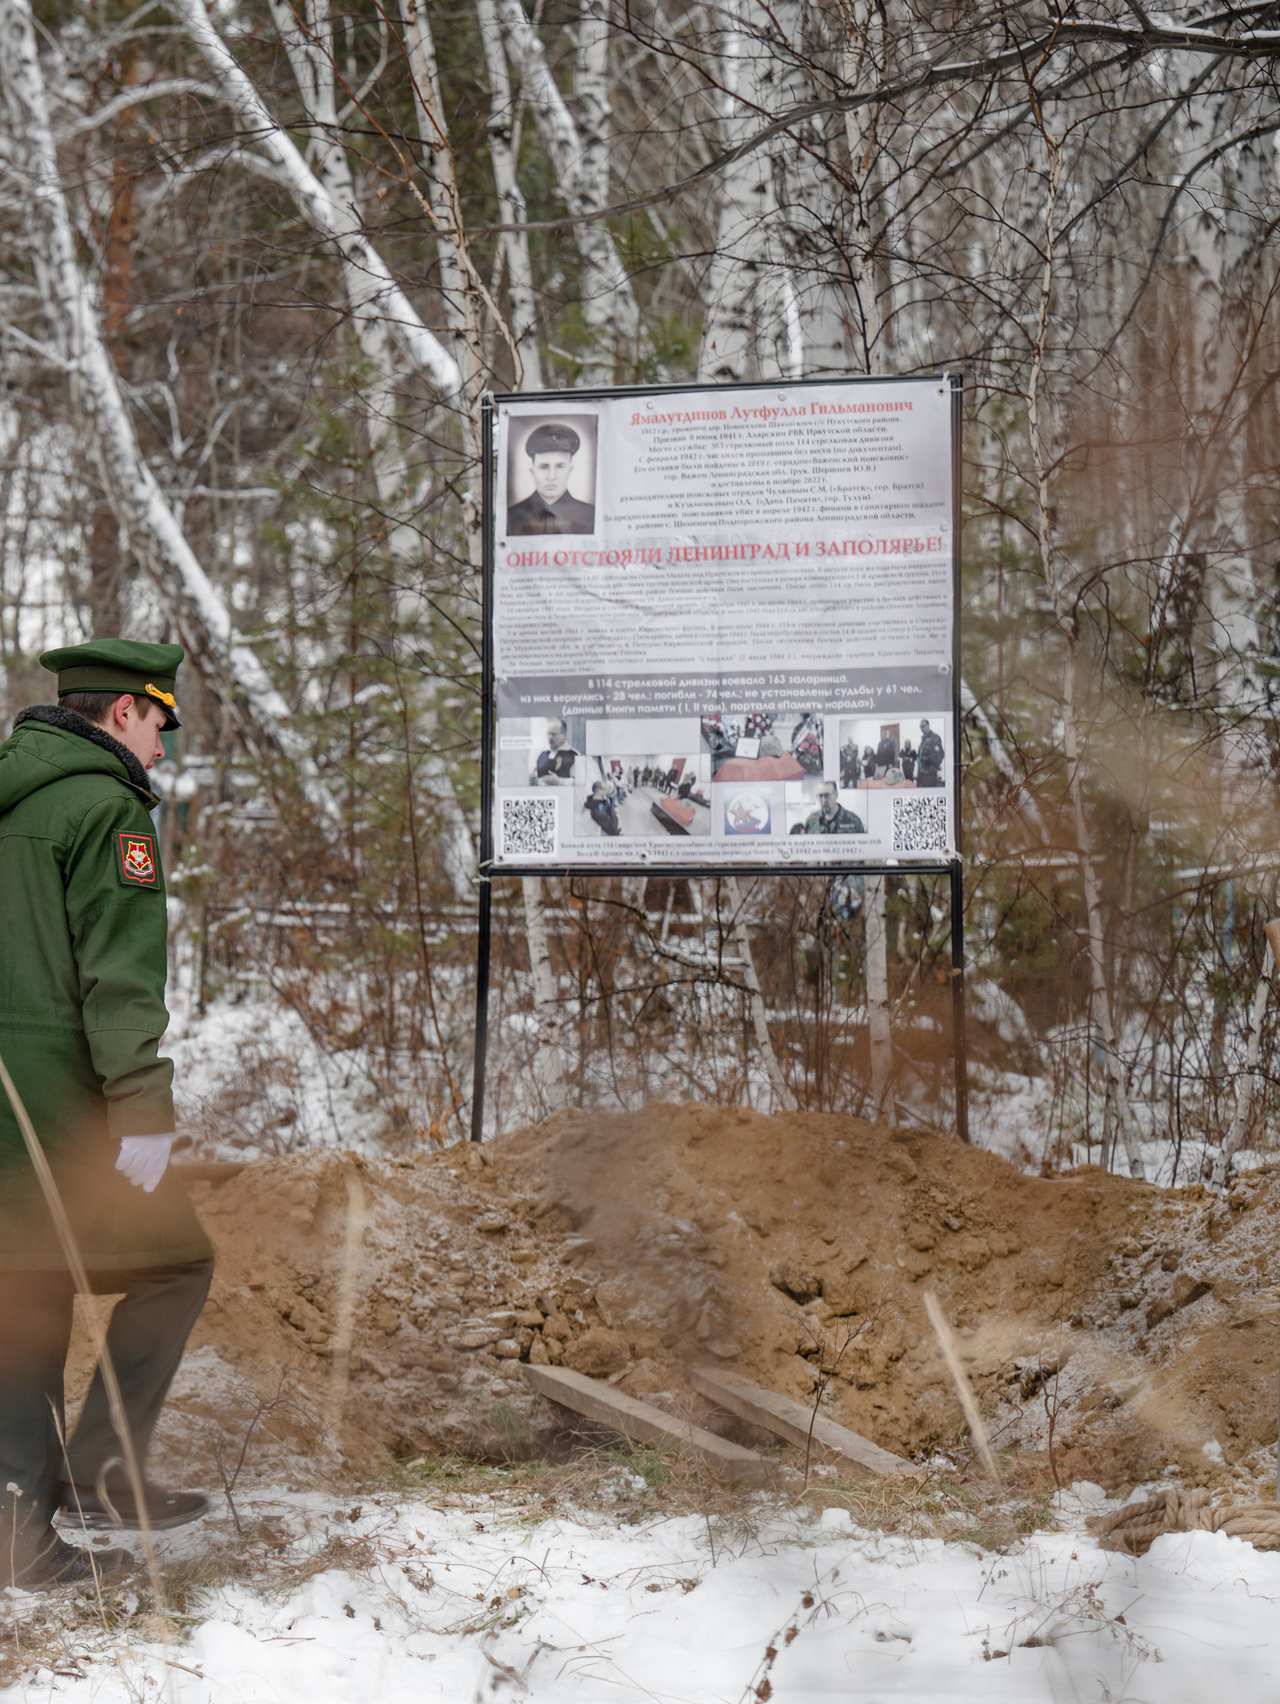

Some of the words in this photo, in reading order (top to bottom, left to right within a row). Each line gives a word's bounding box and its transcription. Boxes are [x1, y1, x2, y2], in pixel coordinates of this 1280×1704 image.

[630, 410, 727, 425] Ямалутдинов
[731, 405, 806, 422] Лутфулла
[810, 400, 913, 415] Гильманович
[653, 436, 686, 444] Призван
[746, 431, 786, 439] Аларским
[806, 427, 851, 435] Иркутской
[710, 470, 770, 478] Ленинградская
[773, 478, 802, 486] ноябре
[620, 494, 685, 502] руководителями
[766, 487, 809, 495] Чулковым
[614, 513, 678, 521] предположению
[718, 517, 783, 526] Подпорожского
[817, 514, 879, 522] Ленинградской
[506, 551, 548, 567] ОНИ
[553, 548, 661, 567] ОТСТОЯЛИ
[667, 543, 790, 563] ЛЕНИНГРАД
[796, 542, 809, 557] И
[816, 537, 942, 556] ЗАПОЛЯРЬЕ!
[588, 679, 594, 689] В
[597, 679, 612, 688] 114
[615, 679, 676, 688] стрелковой
[679, 678, 720, 687] дивизии
[722, 677, 765, 685] воевало
[769, 675, 786, 684] 163
[520, 695, 532, 703] из
[533, 695, 551, 703] них
[553, 694, 604, 703] вернулись
[613, 691, 626, 701] 28
[654, 690, 696, 700] погибли
[706, 689, 717, 698] 74
[761, 688, 832, 698] установлены
[835, 685, 874, 697] судьбы
[876, 687, 883, 696] у
[886, 684, 897, 694] 61
[562, 705, 603, 716] (данные
[605, 704, 635, 713] Книги
[638, 705, 676, 713] памяти
[693, 702, 700, 711] II
[730, 702, 775, 712] портала
